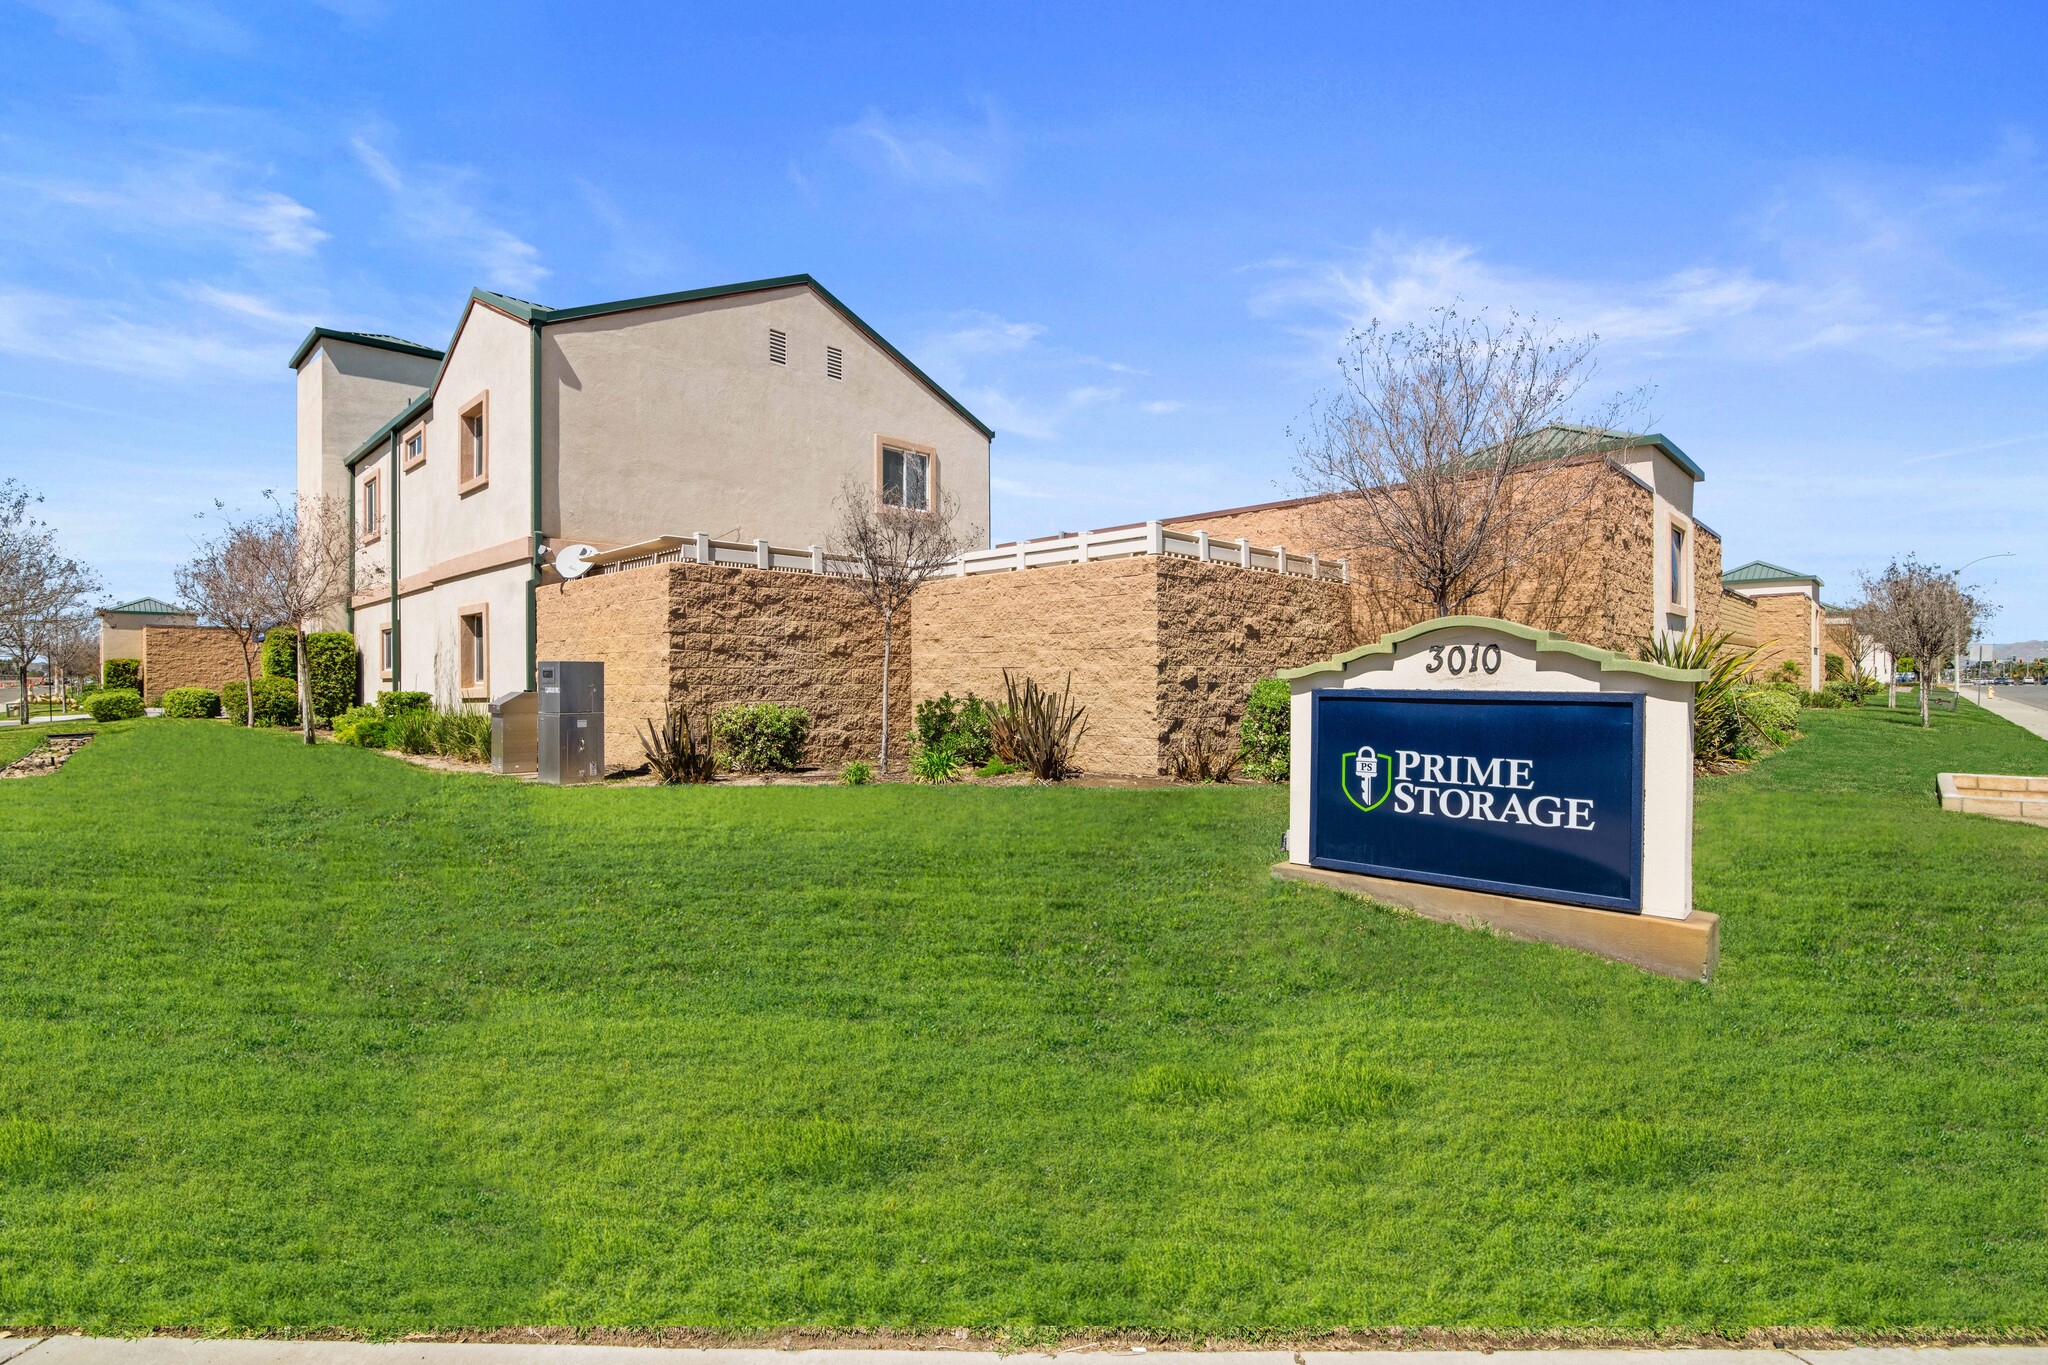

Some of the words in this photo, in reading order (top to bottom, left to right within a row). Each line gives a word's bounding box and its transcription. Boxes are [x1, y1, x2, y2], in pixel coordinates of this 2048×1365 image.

[1425, 642, 1502, 676] 3010
[1360, 762, 1373, 772] PS
[1394, 749, 1535, 790] PRIME
[1394, 782, 1596, 831] STORAGE
